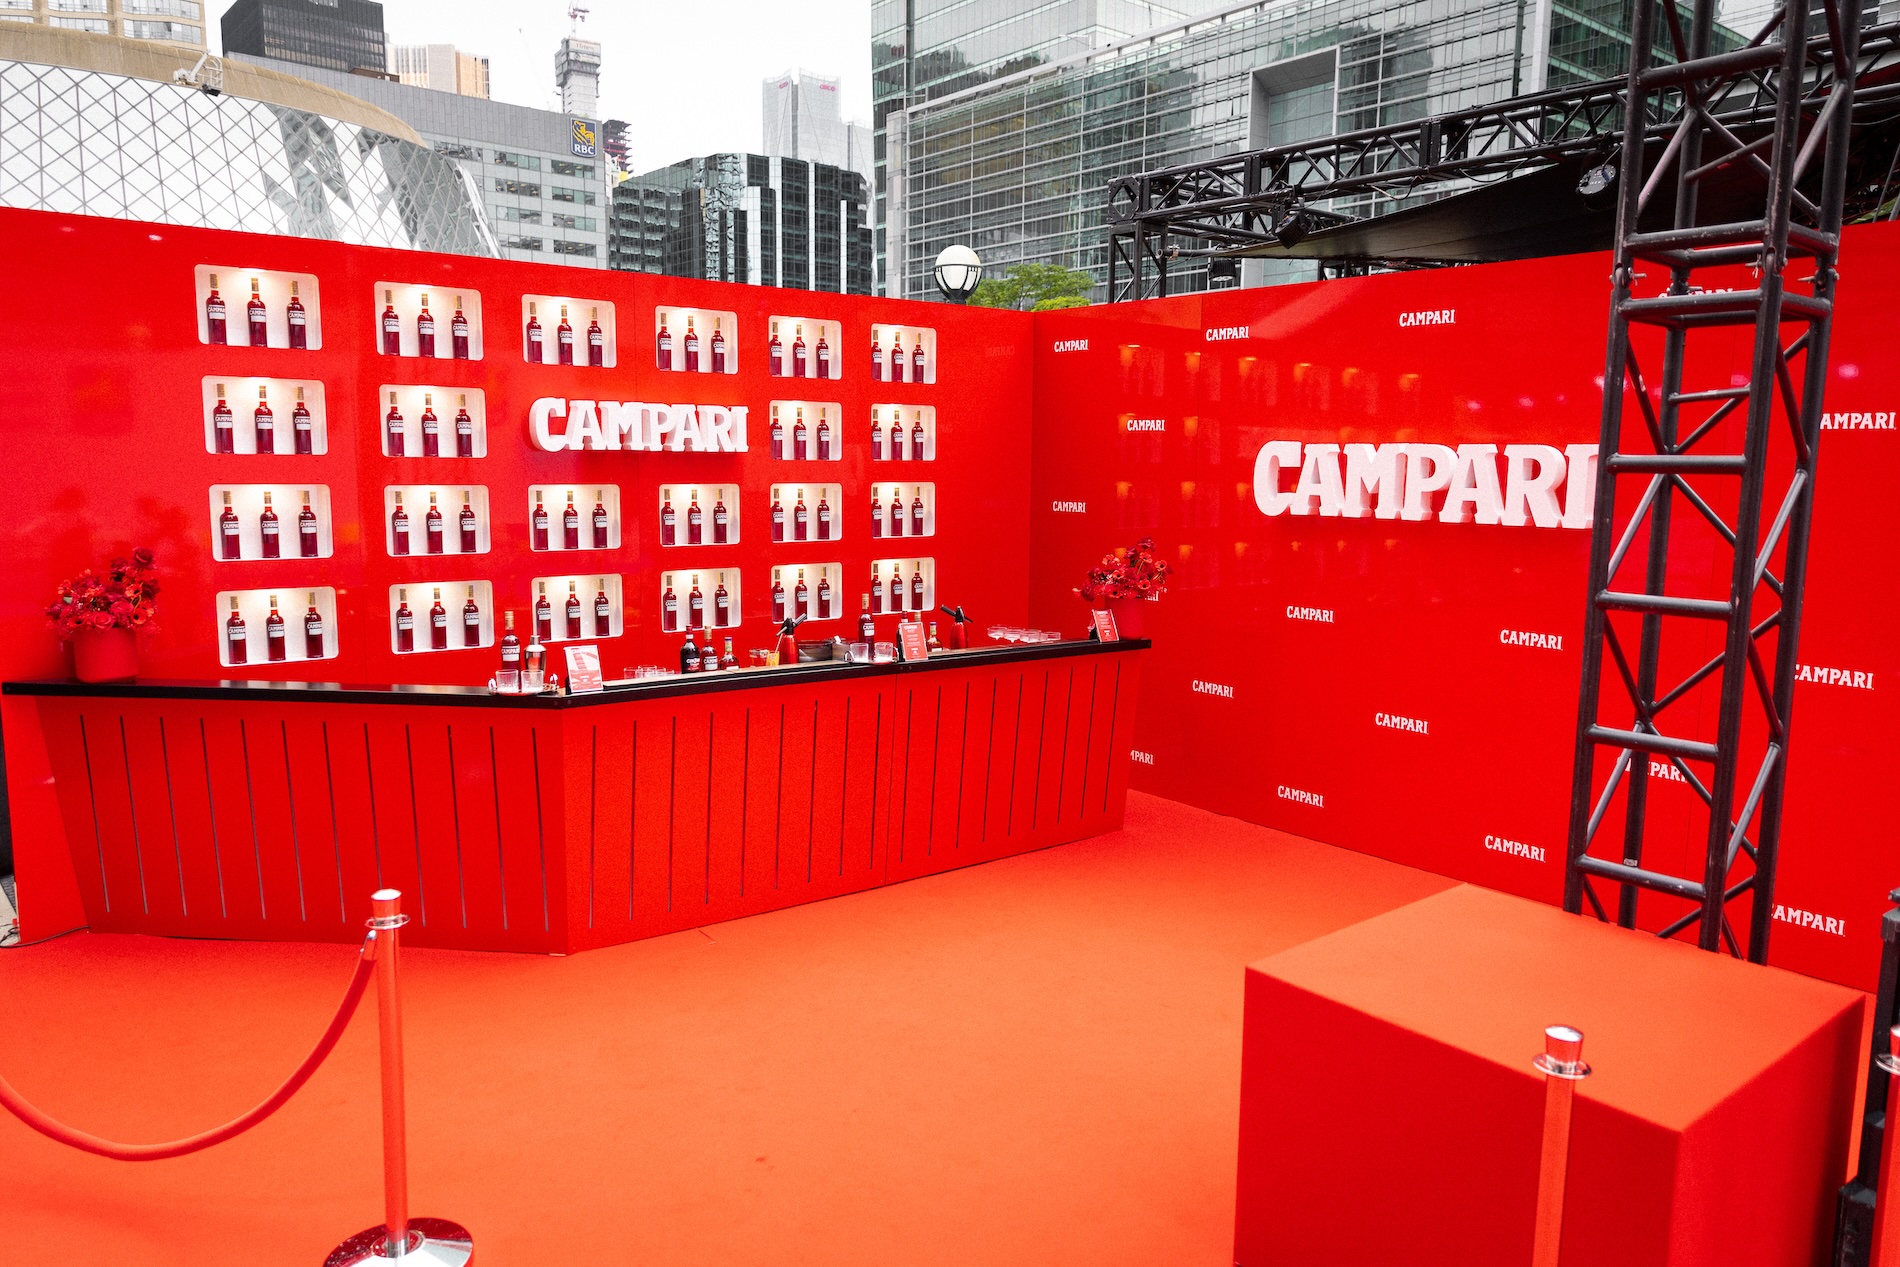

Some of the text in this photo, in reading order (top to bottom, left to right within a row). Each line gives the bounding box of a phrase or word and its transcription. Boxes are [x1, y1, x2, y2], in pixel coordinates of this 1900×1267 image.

[574, 144, 594, 154] RBC
[1399, 310, 1455, 327] CAMPARI
[1206, 326, 1249, 341] CAMPARI
[1054, 340, 1088, 352] CAMPARI
[529, 397, 749, 452] CAMPARI
[1127, 420, 1165, 431] CAMPARI
[1820, 412, 1896, 429] AMPARI
[1253, 440, 1599, 529] CAMPARI
[1053, 501, 1086, 513] CAMPARI
[1287, 606, 1334, 623] CAMPARI
[1500, 629, 1562, 650] CAMPARI
[1192, 680, 1233, 698] CAMPARI
[1376, 713, 1428, 735] CAMPARI
[1278, 785, 1324, 808] CAMPARI
[1485, 835, 1545, 862] CAMPARI
[1771, 903, 1845, 937] AMPARI
